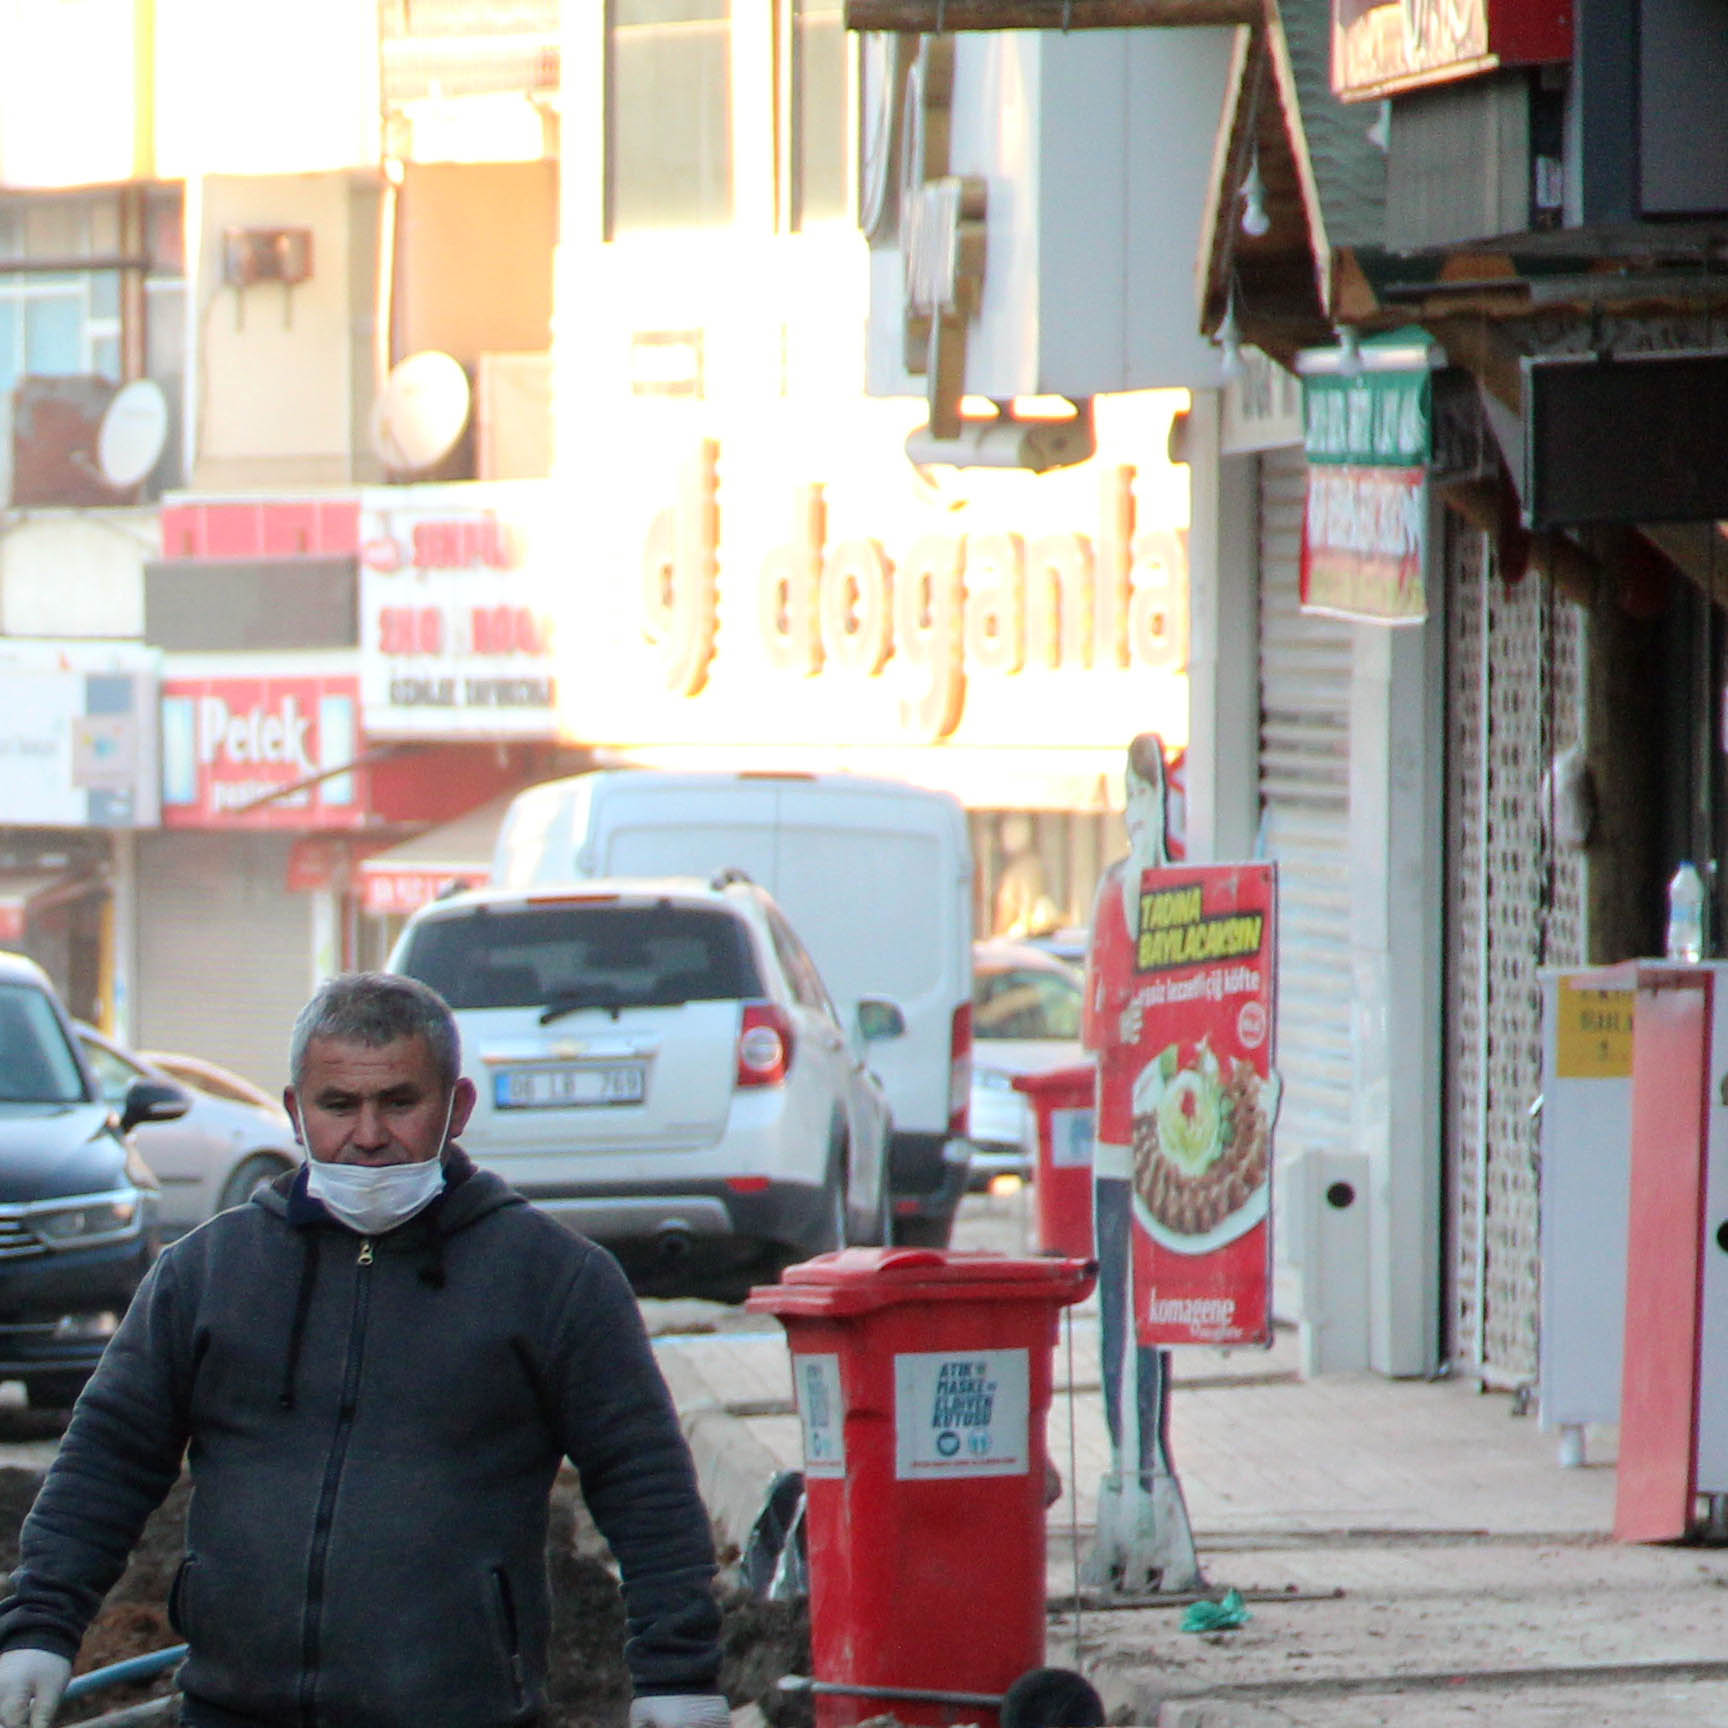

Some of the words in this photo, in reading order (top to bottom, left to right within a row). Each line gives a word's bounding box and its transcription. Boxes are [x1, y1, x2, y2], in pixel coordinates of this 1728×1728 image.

[199, 694, 318, 774] Petek
[1141, 885, 1202, 930] TADINA
[1138, 915, 1262, 969] BAYILACAKSIN
[1149, 1286, 1236, 1333] komagene
[936, 1379, 986, 1395] MASKE
[938, 1362, 973, 1378] ATIK
